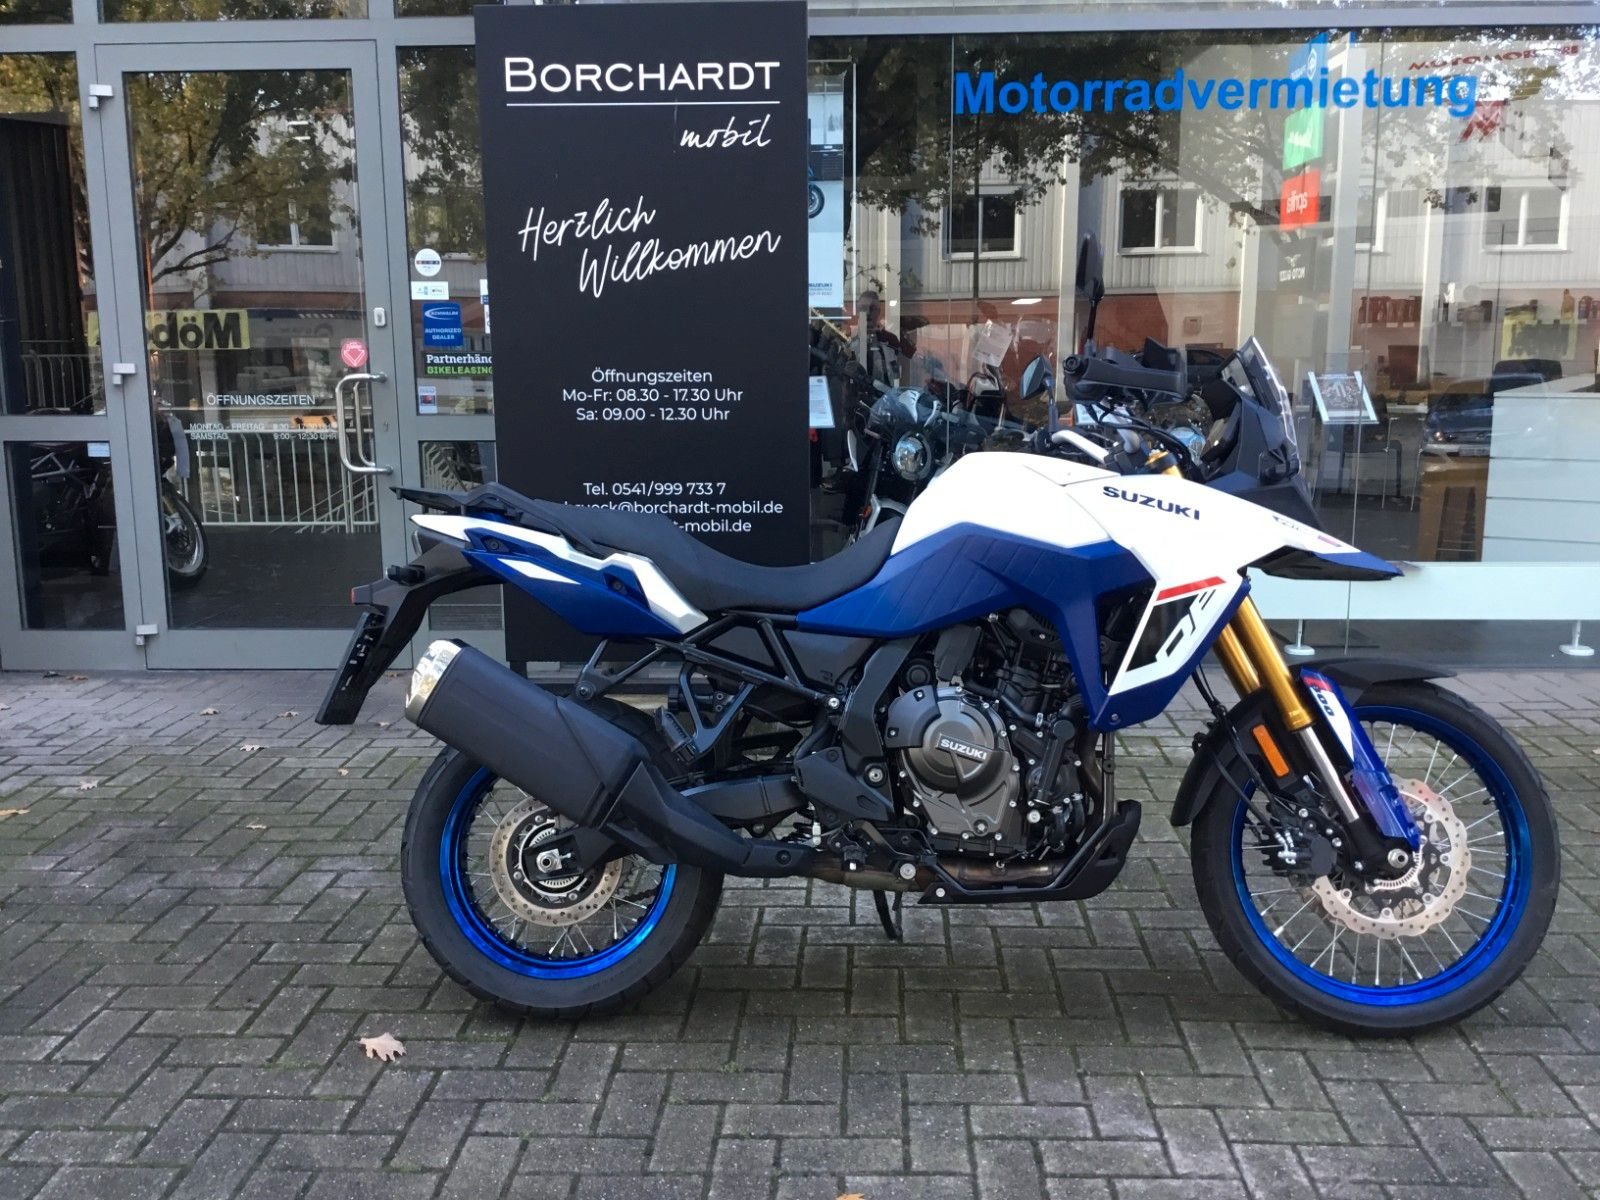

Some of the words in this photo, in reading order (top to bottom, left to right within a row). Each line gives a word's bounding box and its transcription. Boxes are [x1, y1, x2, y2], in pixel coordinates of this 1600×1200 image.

[504, 57, 780, 93] BORCHARDT
[953, 68, 1478, 117] Motorradvermietung
[680, 114, 772, 148] mobil
[518, 195, 656, 261] Herzlich
[579, 230, 782, 298] Willkommen
[591, 366, 713, 385] Öffnungszeiten
[206, 392, 316, 406] ÖFFNUNGSZEITEN
[562, 388, 613, 402] Mo-Fr:
[616, 388, 660, 402] 08.30
[673, 388, 710, 402] 17.30
[714, 387, 744, 402] Uhr
[576, 407, 599, 421] Sa:
[602, 407, 646, 421] 09.00
[659, 407, 697, 421] 12.30
[701, 407, 731, 421] Uhr
[189, 423, 225, 431] MONTAG
[231, 422, 265, 431] FREITAG
[190, 432, 229, 440] SAMSTAG
[320, 432, 337, 440] UHR
[583, 482, 609, 496] Tel.
[612, 480, 683, 497] 0541/999
[686, 482, 714, 496] 733
[716, 482, 726, 496] 7
[564, 500, 784, 514] k@borchardt-mobil.de
[1103, 486, 1200, 520] SUZUKI
[673, 519, 752, 533] -mobil.de
[940, 737, 988, 761] SUZUKI
